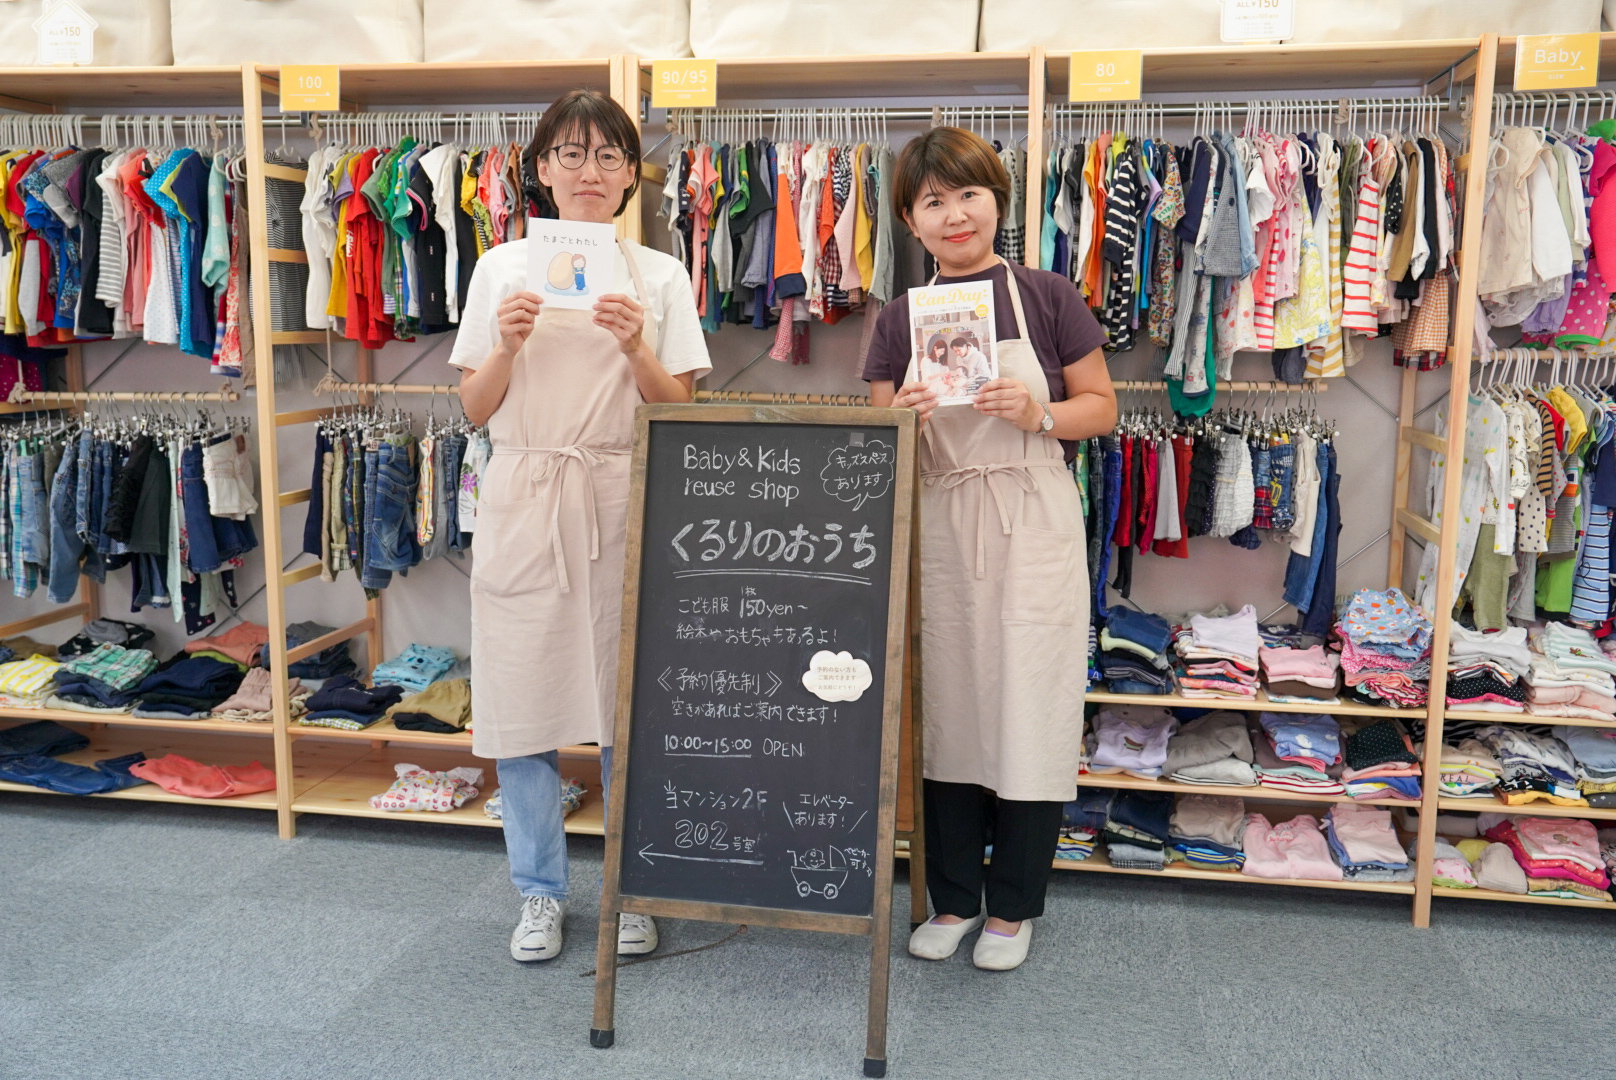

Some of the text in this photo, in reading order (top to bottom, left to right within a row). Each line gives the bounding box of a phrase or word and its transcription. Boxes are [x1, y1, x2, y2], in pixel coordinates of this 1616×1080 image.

[1534, 47, 1583, 67] Baby
[662, 69, 707, 85] 90/95
[1096, 62, 1115, 77] 80
[1547, 72, 1565, 81] size
[298, 76, 322, 89] 100
[543, 235, 598, 247] たまごとわたし
[835, 451, 888, 470] キッズスペース
[833, 471, 883, 490] あります
[684, 477, 800, 508] reuse shop
[670, 518, 877, 570] くるりのおうち
[677, 596, 729, 616] こども服
[762, 738, 804, 757] OPEN
[799, 793, 855, 810] エレベーター
